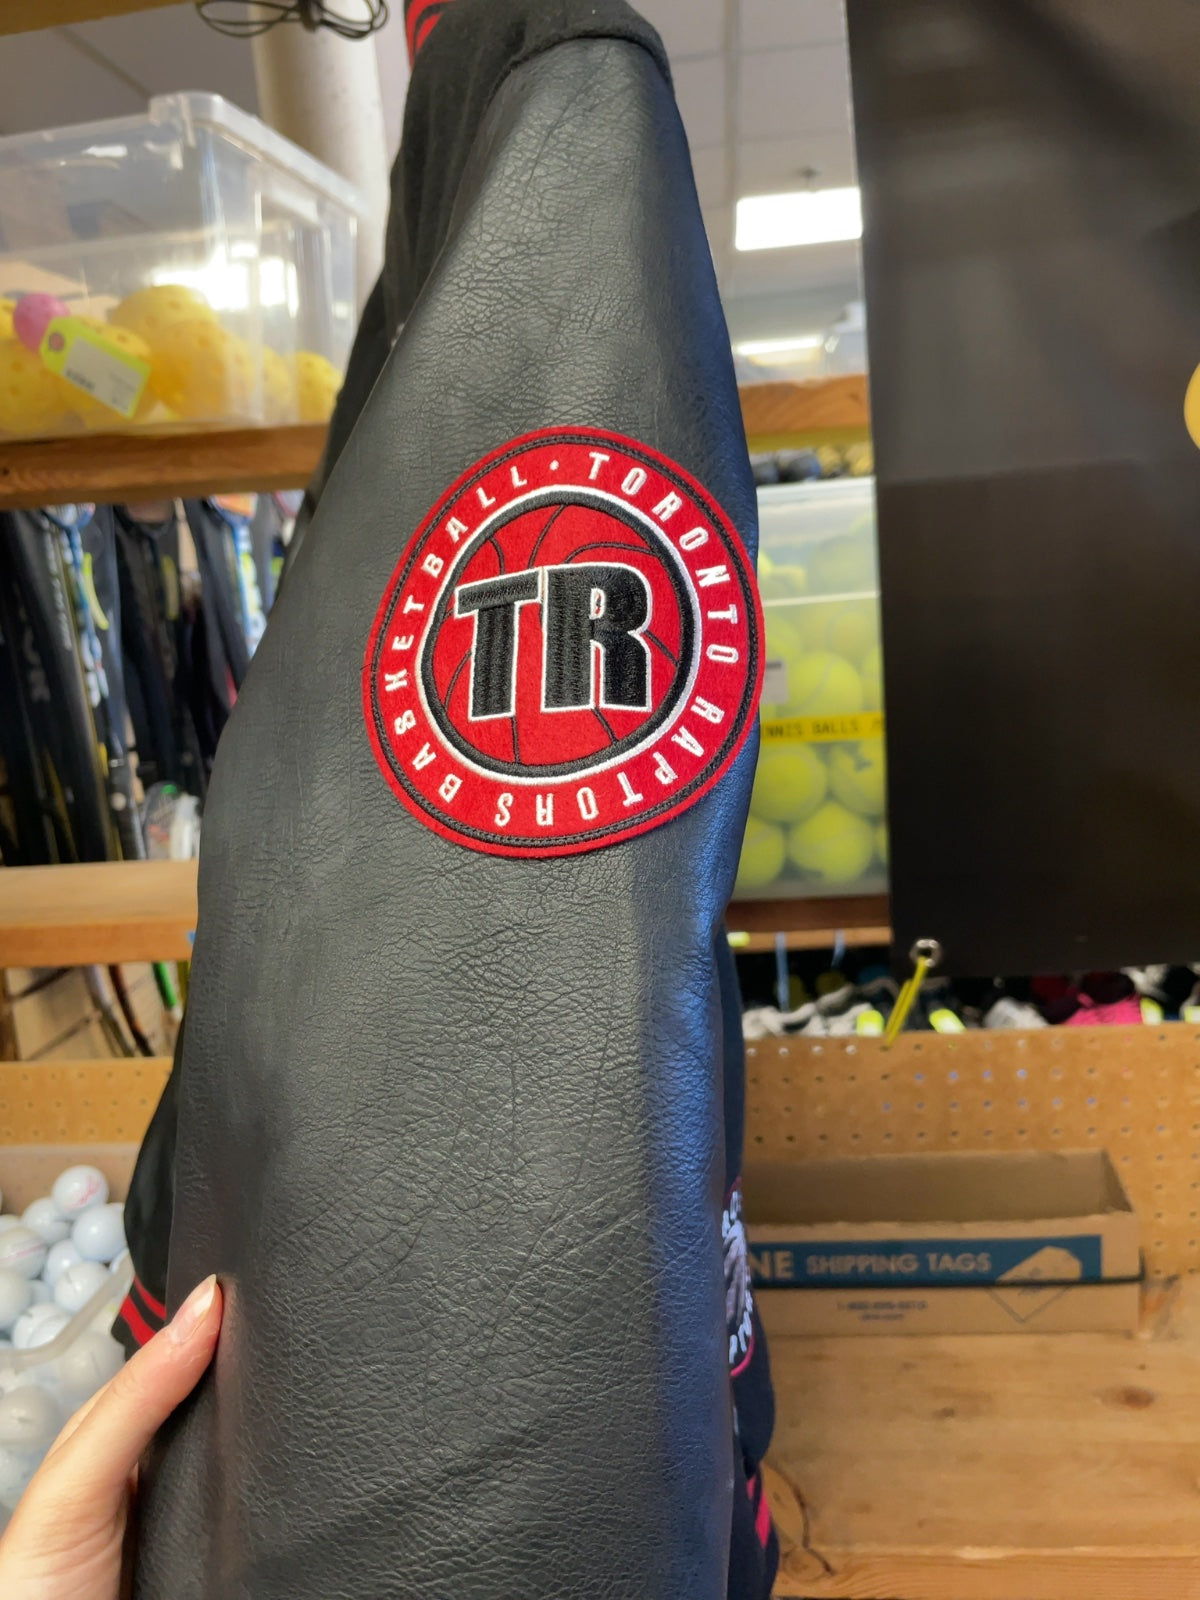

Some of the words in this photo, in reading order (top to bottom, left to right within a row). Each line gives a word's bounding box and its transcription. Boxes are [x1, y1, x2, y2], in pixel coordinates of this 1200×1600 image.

[384, 465, 528, 804] BASKETBALL
[588, 451, 740, 664] TORONTO
[453, 561, 653, 723] TR
[494, 695, 726, 827] RAPTORS
[806, 1252, 920, 1276] SHIPPING
[927, 1251, 993, 1274] TAGS
